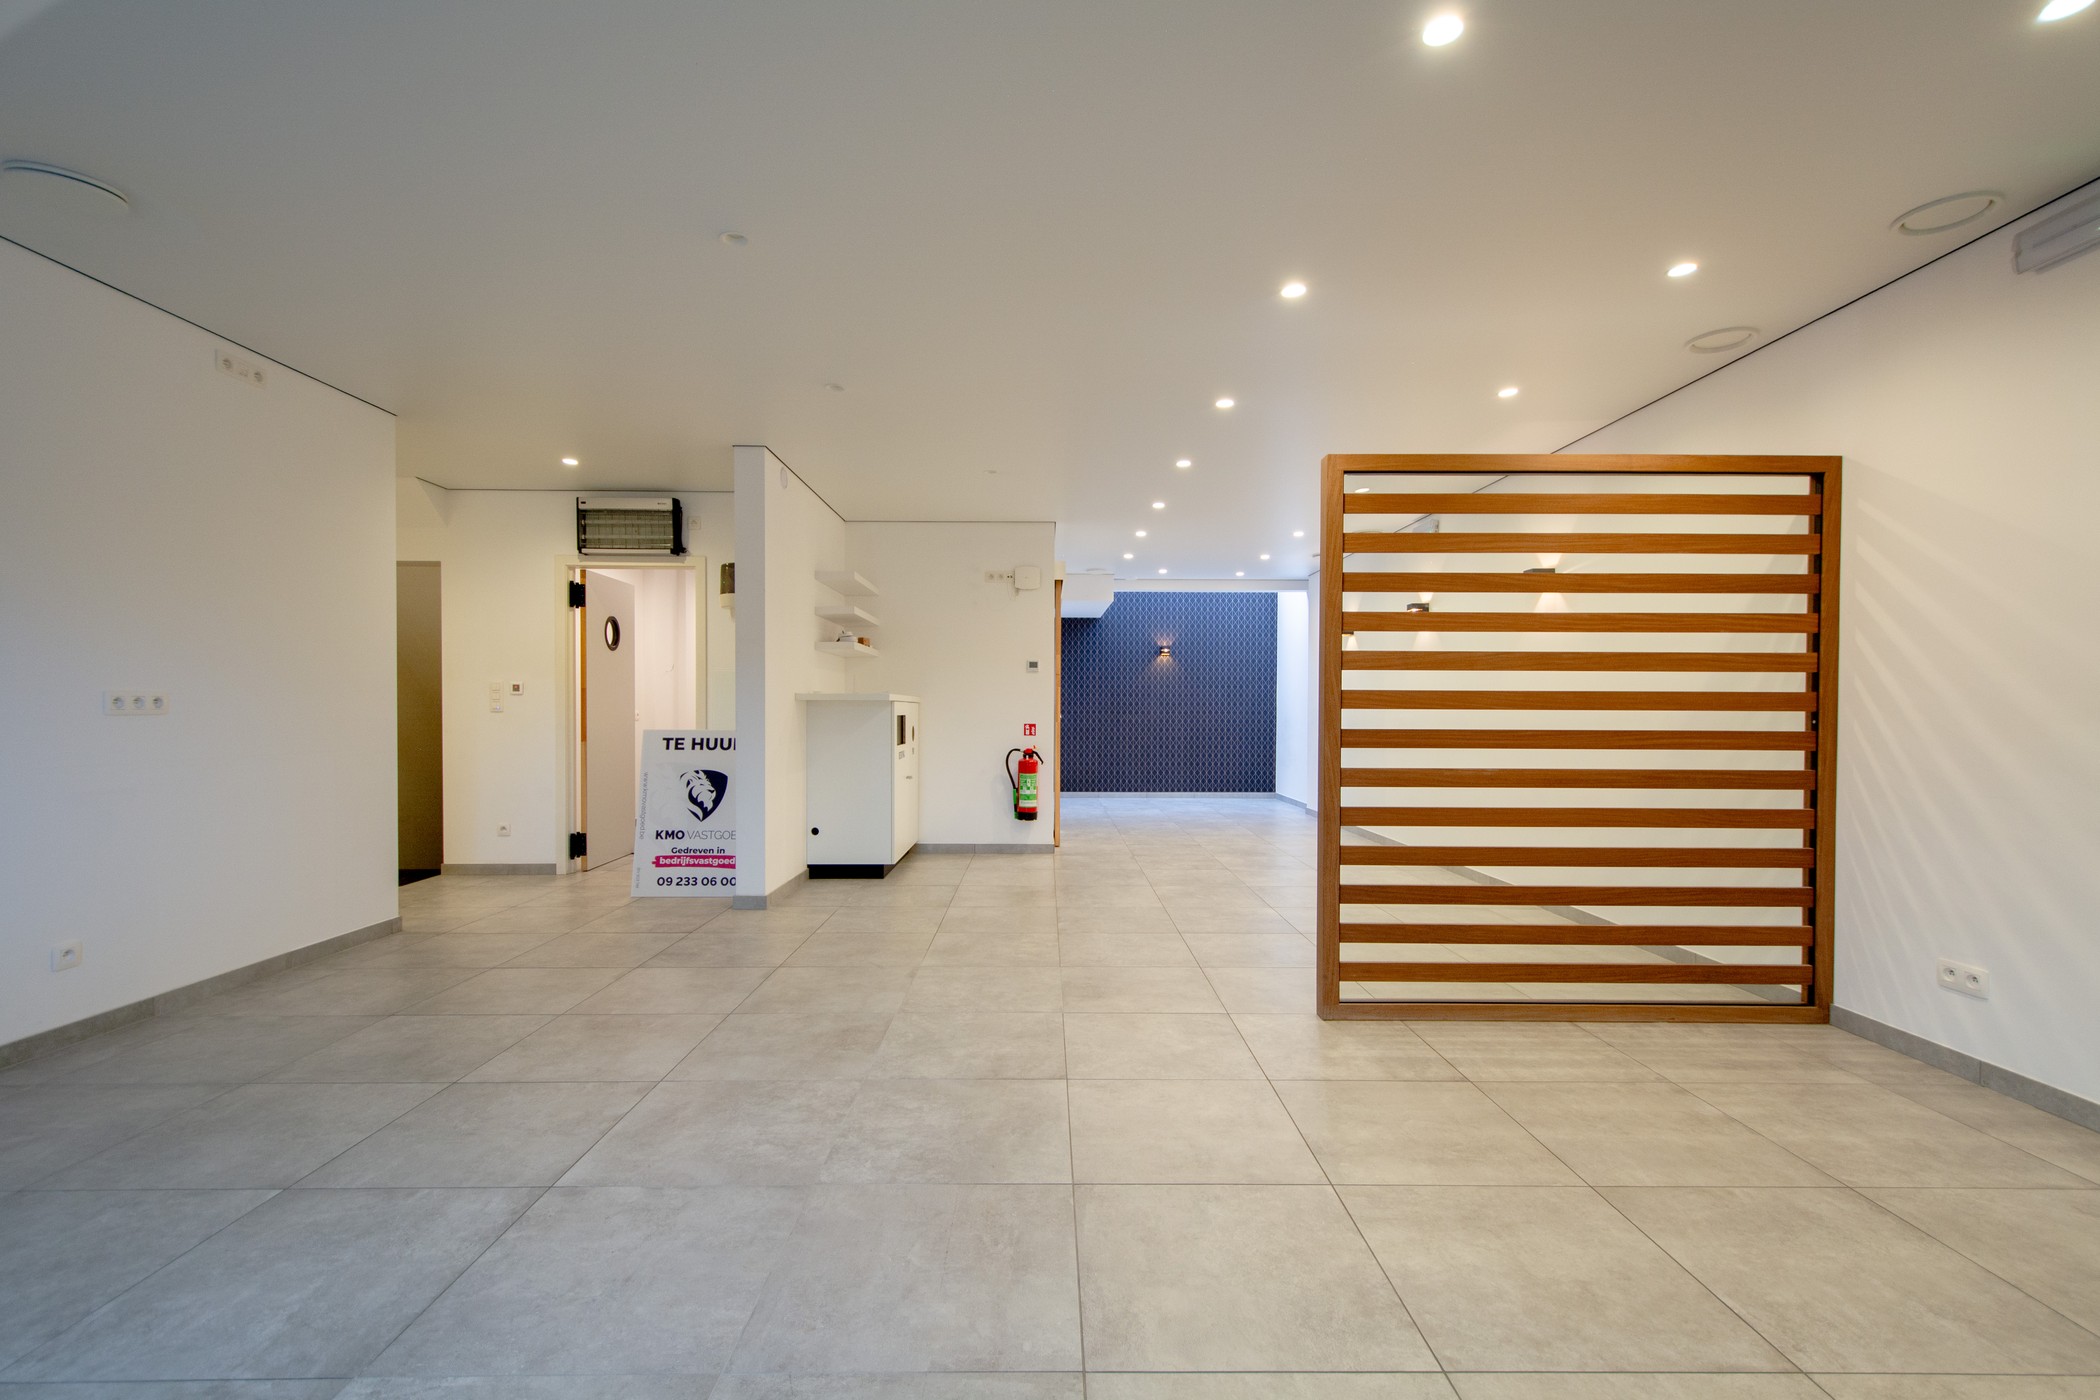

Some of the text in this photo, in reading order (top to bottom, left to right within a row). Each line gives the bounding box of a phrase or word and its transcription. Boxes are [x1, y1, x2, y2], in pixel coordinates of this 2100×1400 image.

[662, 737, 737, 751] TE HUU
[655, 830, 736, 840] KMO VASTGOE
[659, 856, 736, 866] bedrijfsvastgoed
[657, 876, 673, 887] 09
[675, 876, 698, 887] 233
[701, 876, 717, 887] 06
